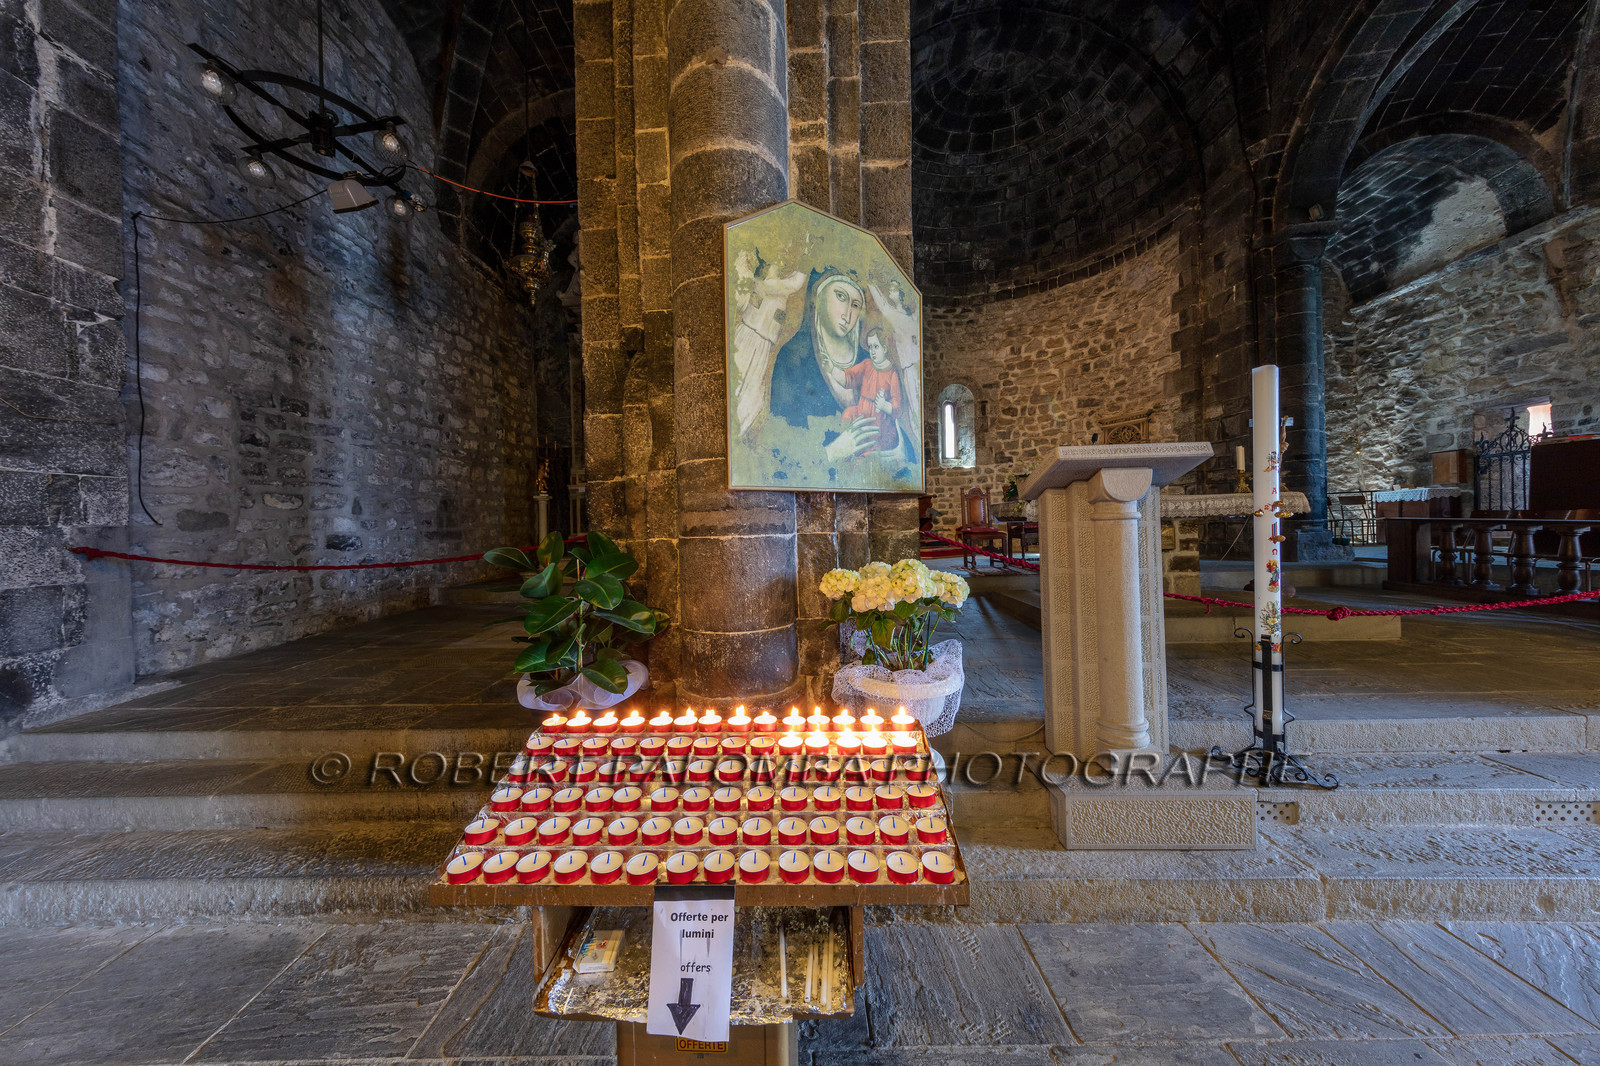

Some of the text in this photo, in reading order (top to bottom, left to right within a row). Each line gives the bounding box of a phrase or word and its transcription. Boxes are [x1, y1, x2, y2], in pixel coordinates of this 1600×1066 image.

[670, 912, 728, 924] Offerte per
[682, 929, 714, 938] lumini
[680, 962, 711, 972] offers
[680, 1040, 724, 1050] OFFERTE
